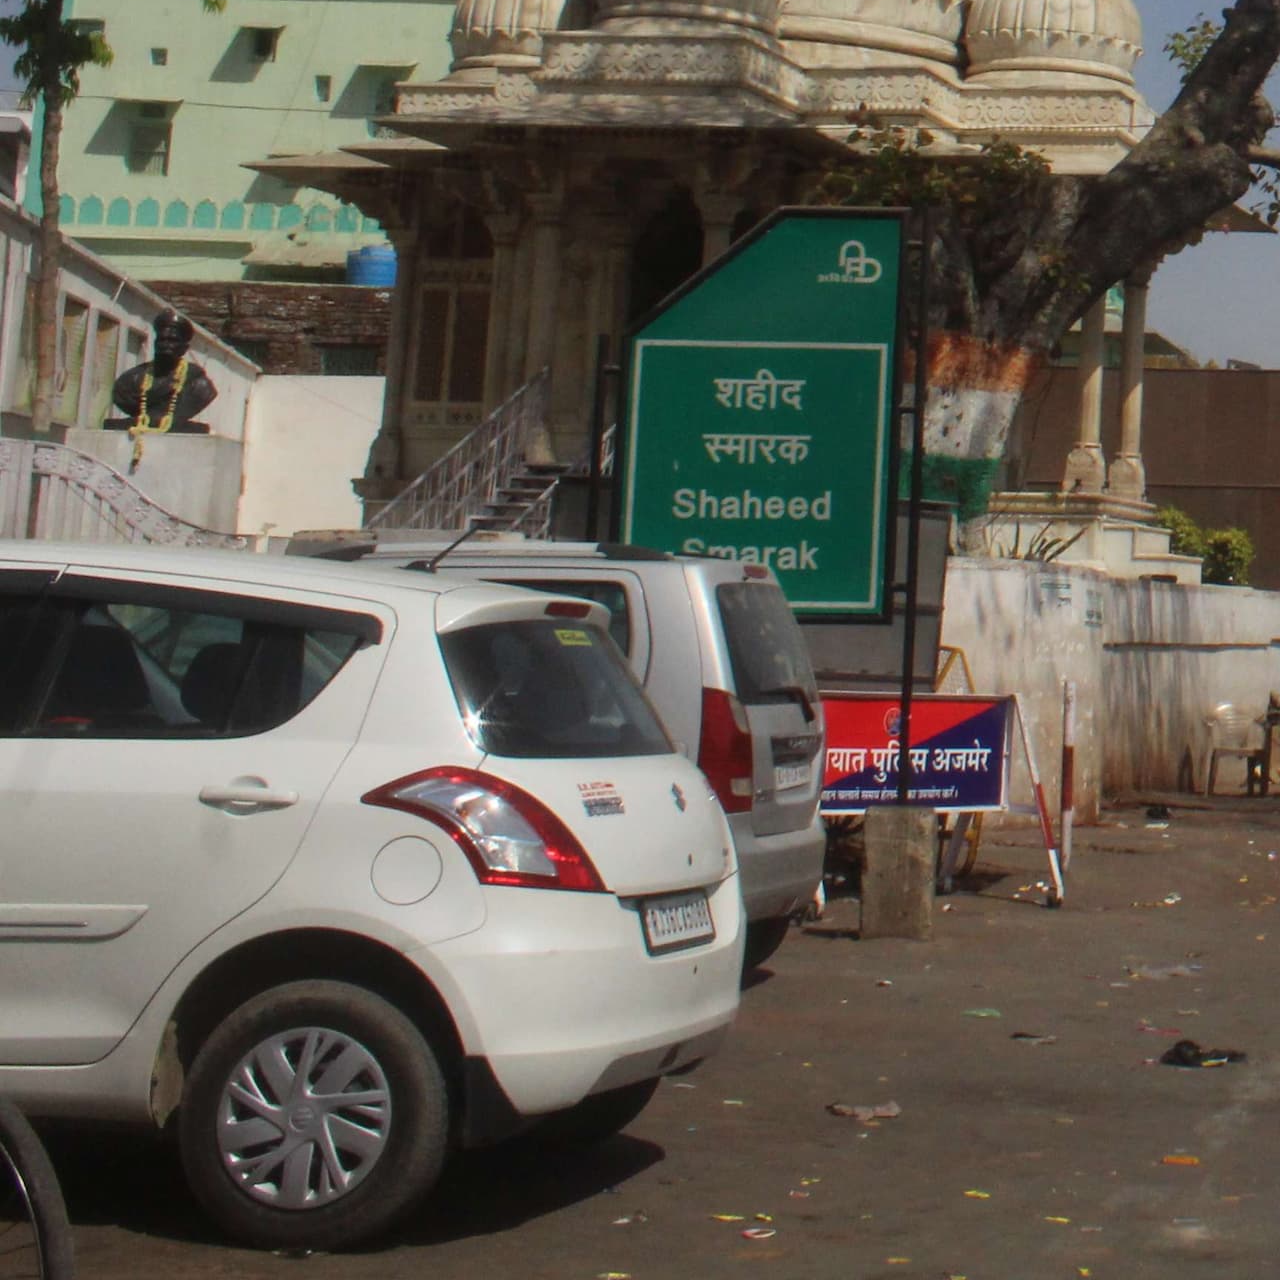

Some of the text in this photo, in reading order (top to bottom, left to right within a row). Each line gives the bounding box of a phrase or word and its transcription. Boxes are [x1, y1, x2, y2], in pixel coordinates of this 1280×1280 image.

[713, 368, 807, 411] शहीद
[702, 433, 812, 464] स्मारक
[672, 487, 832, 521] Shaheed
[682, 538, 819, 570] Smarak
[933, 739, 992, 772] अजमेर
